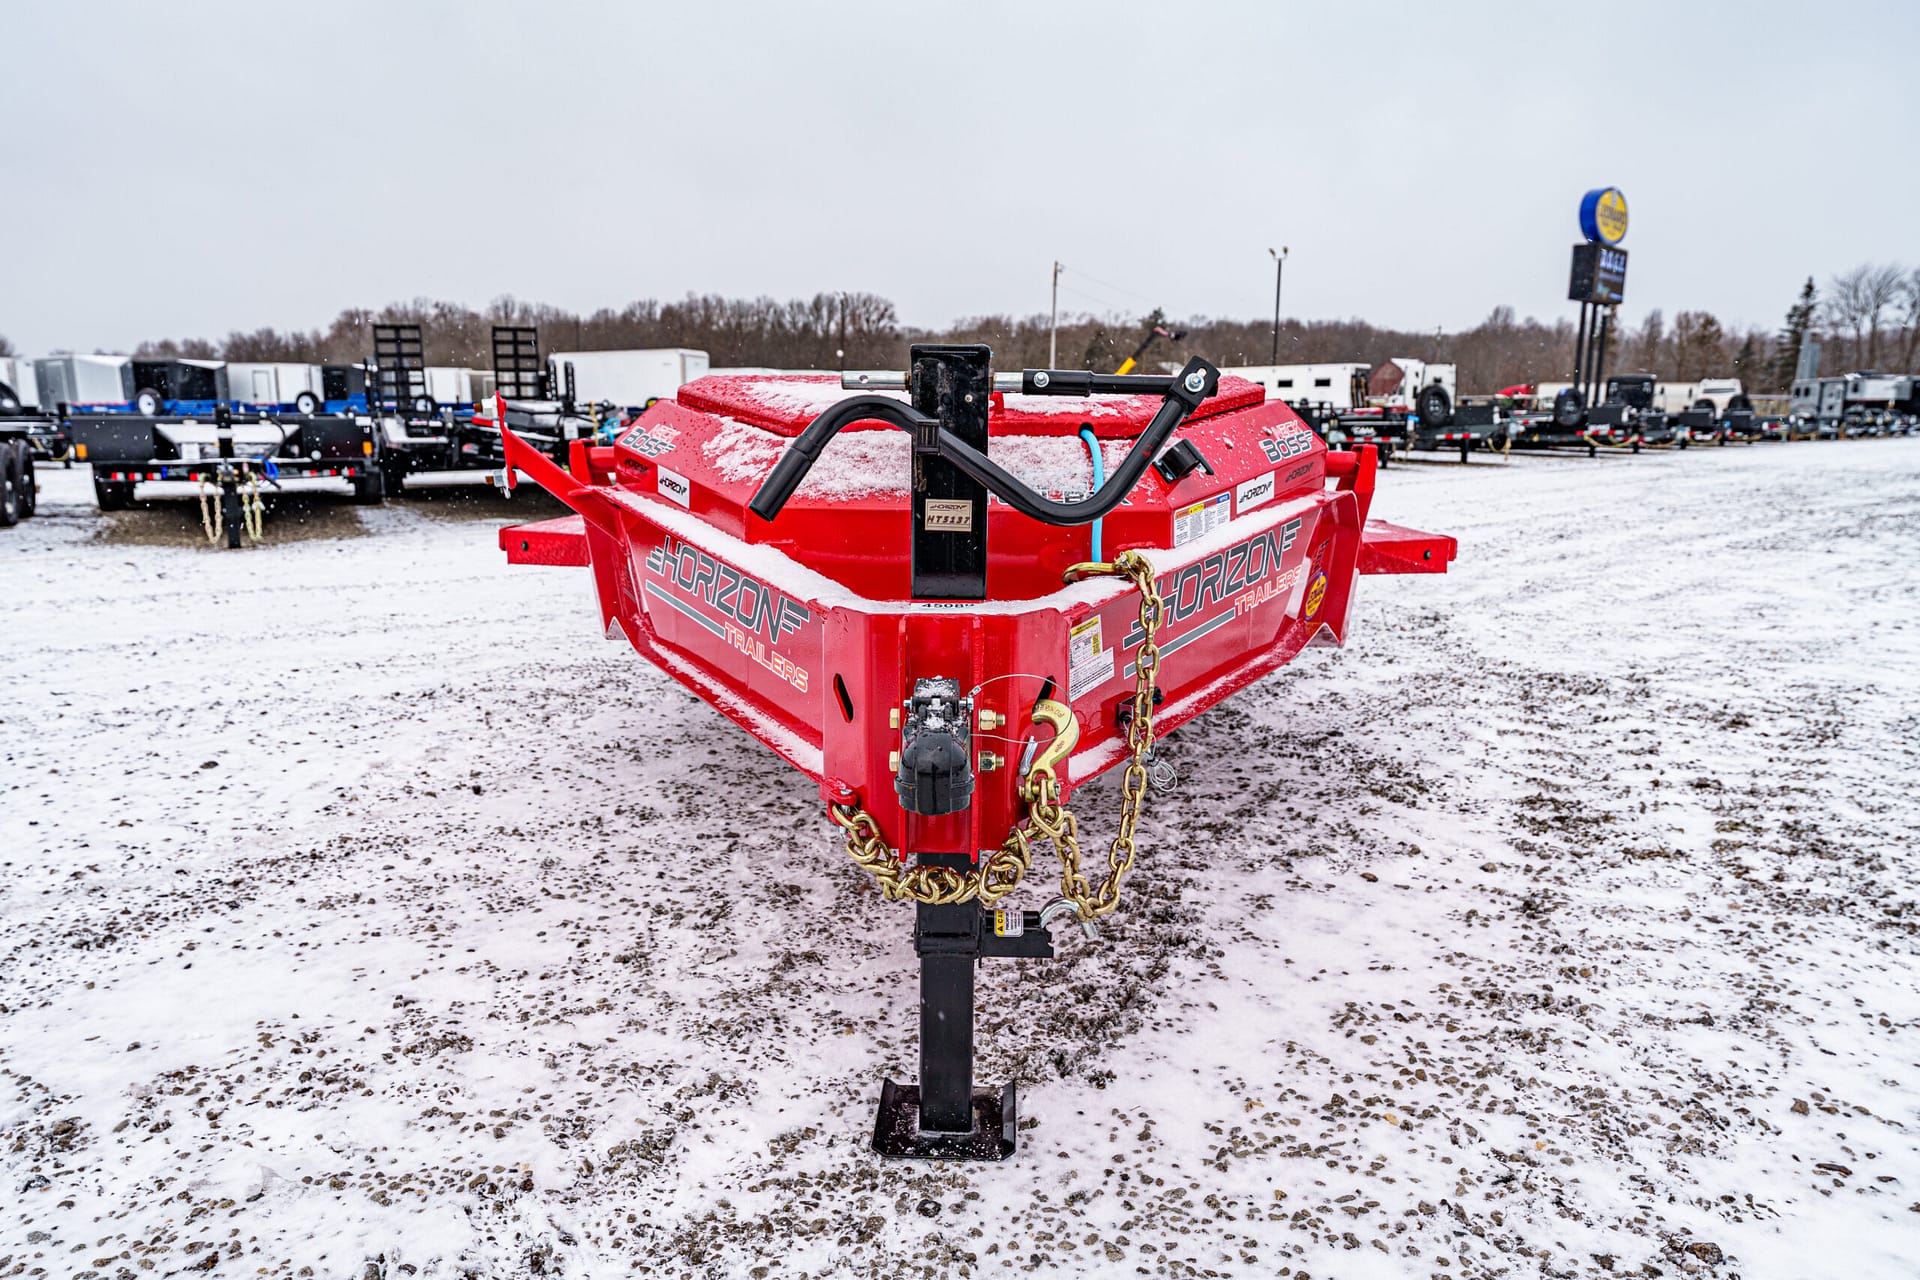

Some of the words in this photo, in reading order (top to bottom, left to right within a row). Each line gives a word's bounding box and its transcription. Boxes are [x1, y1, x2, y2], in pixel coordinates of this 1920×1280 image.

[620, 425, 673, 458] BOSS
[1258, 430, 1312, 464] BOSS
[1239, 481, 1273, 503] HORIZON
[927, 515, 970, 525] HT5137
[655, 535, 797, 644] HORIZON
[1140, 521, 1295, 634] HORIZON
[1234, 564, 1302, 616] TRAILERS
[724, 621, 809, 693] TRAILERS
